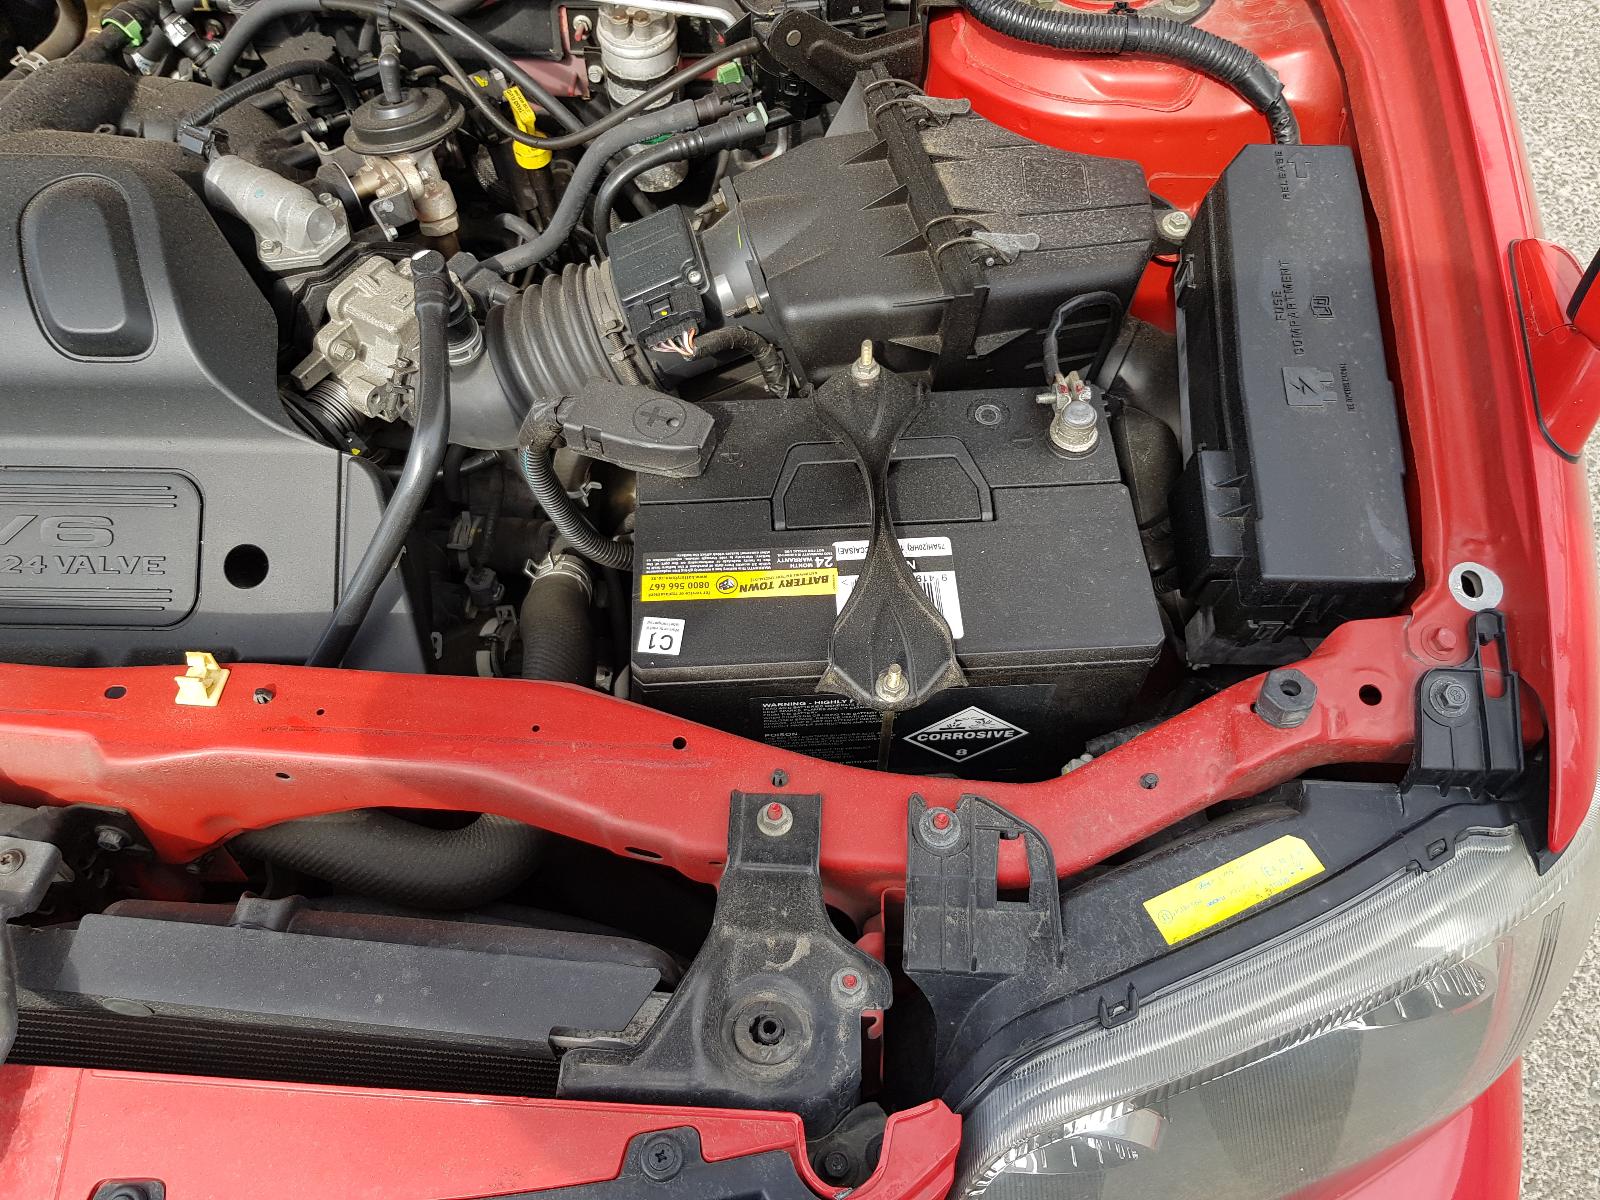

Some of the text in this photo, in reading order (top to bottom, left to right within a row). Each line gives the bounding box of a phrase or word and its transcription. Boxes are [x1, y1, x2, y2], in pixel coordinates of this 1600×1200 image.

[1274, 150, 1291, 200] RELEASE
[1271, 290, 1287, 321] FUSE
[1278, 259, 1305, 356] COMPARTMENT
[0, 554, 166, 575] 24 VALVE
[815, 556, 833, 568] 24
[649, 583, 666, 591] 667
[688, 582, 710, 590] 0800
[740, 581, 775, 593] TOWN
[778, 575, 829, 589] BATTERY
[648, 632, 673, 650] C1
[916, 729, 1015, 742] CORROSIVE
